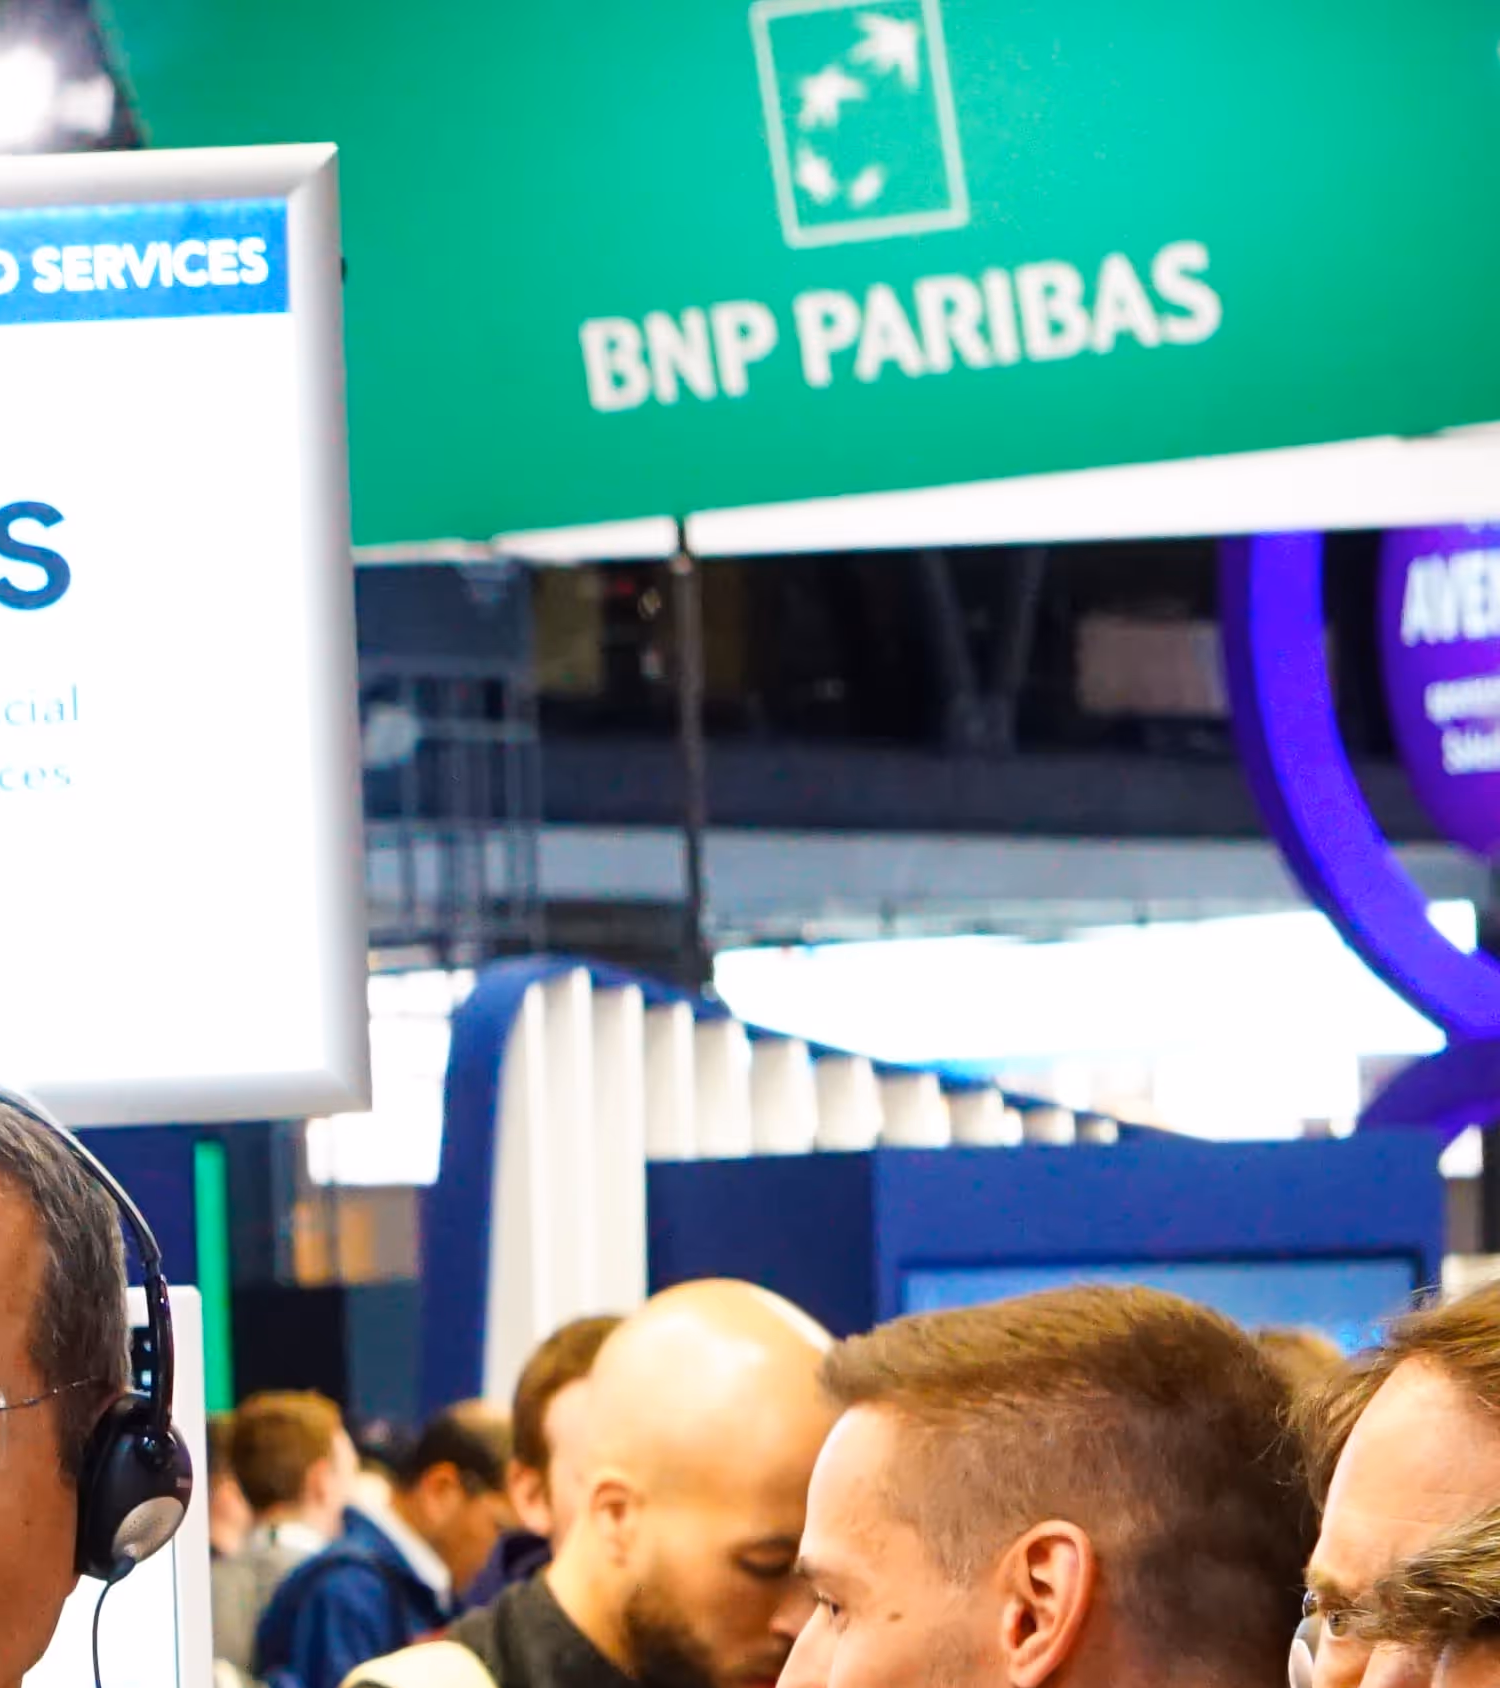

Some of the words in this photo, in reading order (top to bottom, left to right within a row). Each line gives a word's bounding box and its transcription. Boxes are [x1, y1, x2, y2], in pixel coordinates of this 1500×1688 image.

[30, 236, 269, 293] SERVICES
[578, 300, 779, 412] BNP
[792, 240, 1223, 388] PARIBAS
